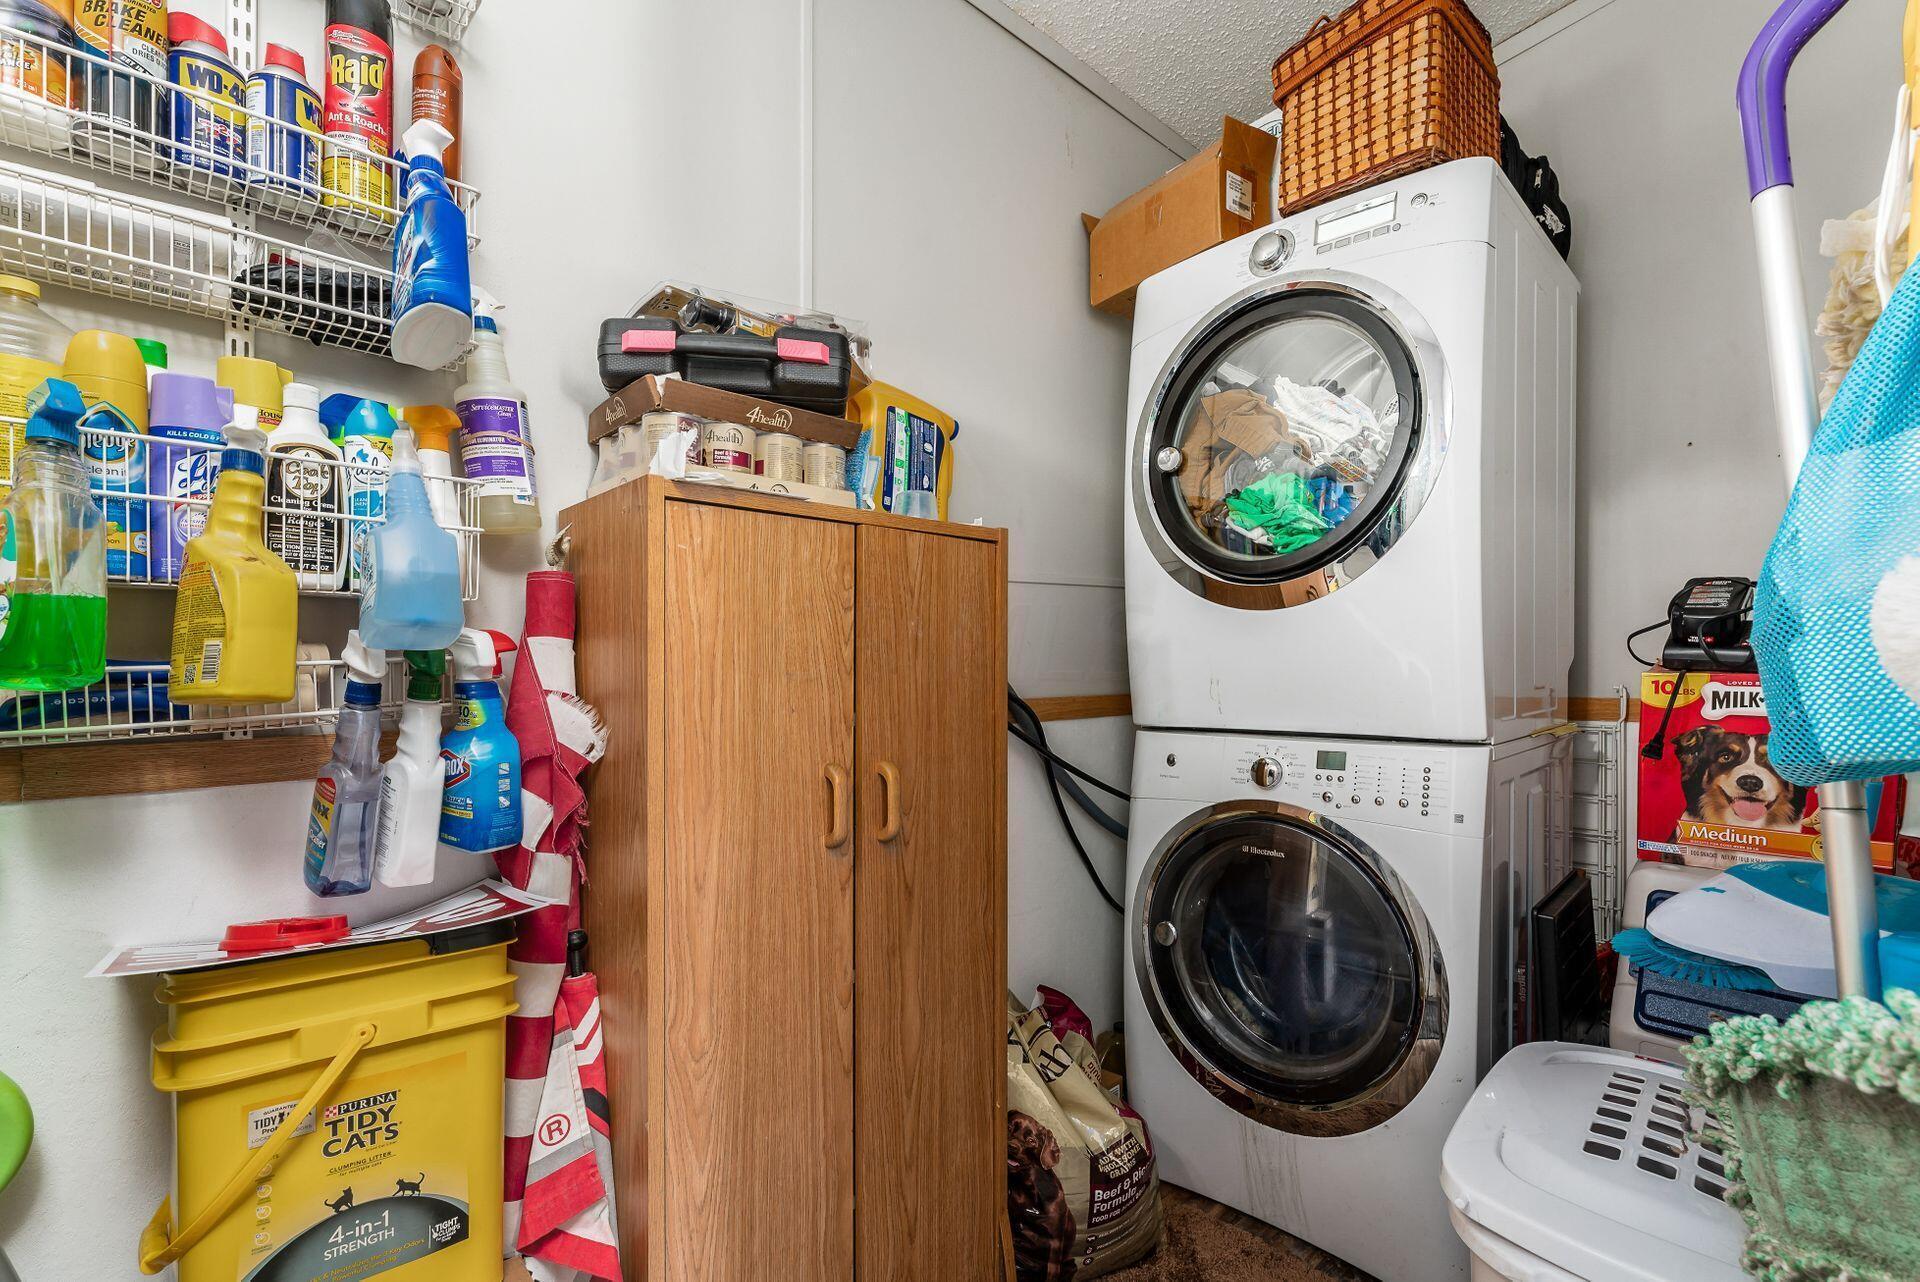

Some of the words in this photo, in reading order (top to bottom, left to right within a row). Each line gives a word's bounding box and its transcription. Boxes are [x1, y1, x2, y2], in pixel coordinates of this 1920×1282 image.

[83, 0, 147, 22] BRAKE
[331, 53, 385, 91] Raid
[328, 112, 343, 121] Ant
[353, 114, 384, 136] Roach
[745, 406, 793, 432] 4health
[167, 429, 187, 437] KILLS
[189, 431, 209, 439] COLD
[704, 428, 744, 446] 4health
[293, 476, 323, 494] Top
[271, 495, 310, 507] Clanig
[1652, 679, 1675, 695] 10
[1711, 690, 1764, 710] MILK-
[1690, 825, 1767, 846] Medium
[341, 1092, 396, 1115] PURINA
[254, 1115, 277, 1130] TIDY
[324, 1103, 397, 1138] TIDY
[322, 1122, 399, 1158] CATS
[329, 1158, 367, 1174] CLUMPING
[368, 1151, 392, 1163] LITTER
[1093, 1186, 1138, 1214] Formula
[1094, 1182, 1122, 1202] Beef
[1123, 1178, 1131, 1190] &
[328, 1209, 391, 1244] 4-in-1
[434, 1216, 459, 1232] TIGHT
[323, 1226, 396, 1261] STRENGTH
